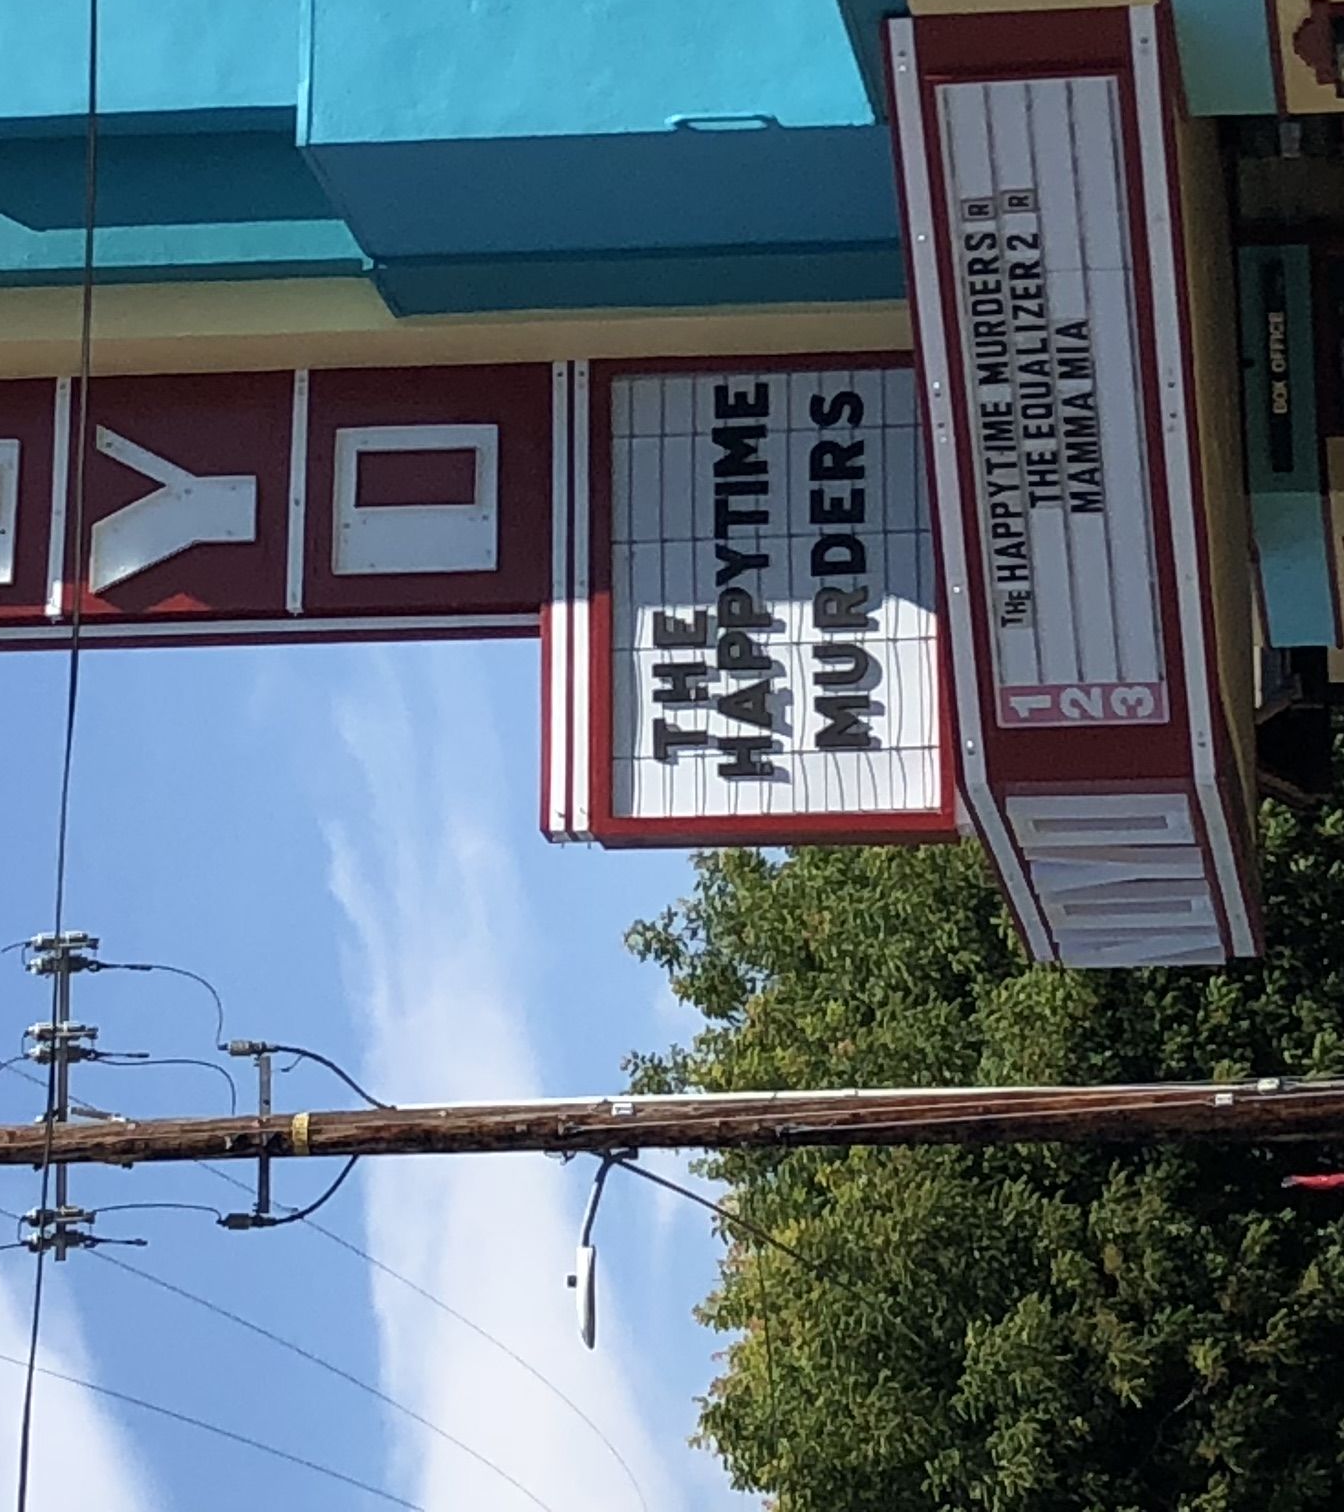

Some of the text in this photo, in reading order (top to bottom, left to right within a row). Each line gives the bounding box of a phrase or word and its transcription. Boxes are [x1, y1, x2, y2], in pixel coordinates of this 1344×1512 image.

[964, 233, 1010, 386] MURDERS
[1006, 233, 1040, 251] 2
[1009, 260, 1056, 439] EQUALIZER
[1268, 311, 1288, 414] BOX OFFICE
[980, 401, 1029, 583] HAPPYTIME
[1026, 450, 1064, 508] THE
[1055, 319, 1154, 717] 3 MAMMA MIA
[712, 381, 775, 778] HAPPYTIME
[810, 391, 872, 748] MURDERS
[1001, 590, 1031, 628] THE
[652, 611, 709, 761] THE
[1009, 694, 1051, 718] 1
[1060, 687, 1104, 718] 2
[1006, 793, 1226, 969] NOYO
